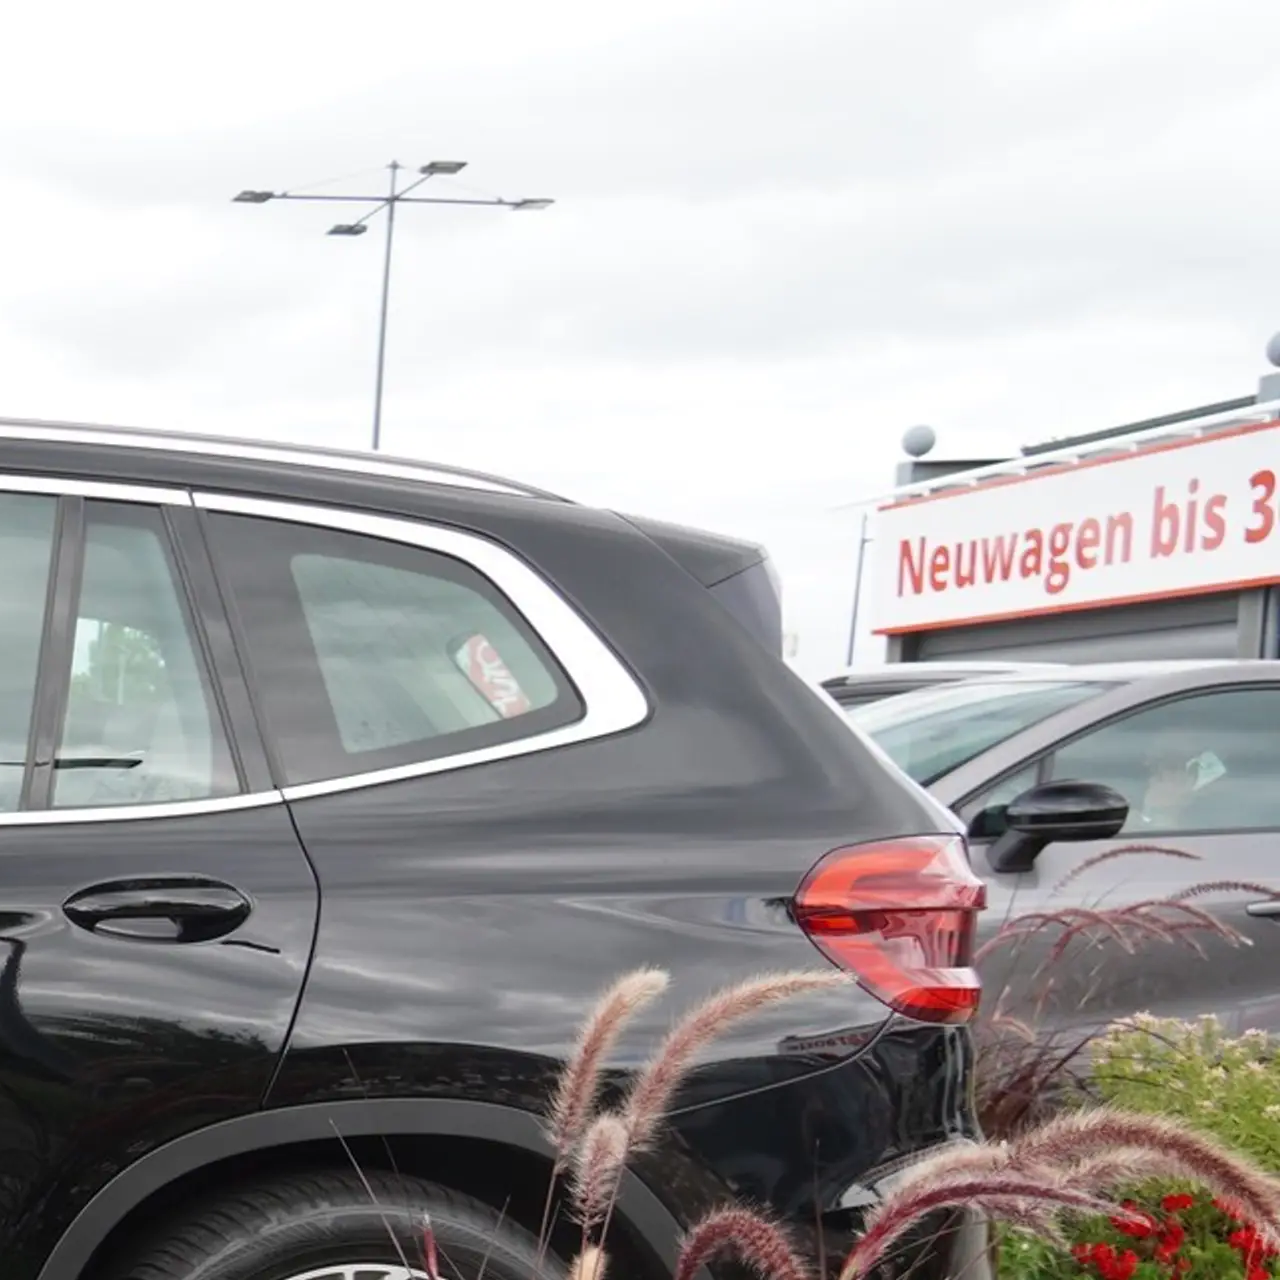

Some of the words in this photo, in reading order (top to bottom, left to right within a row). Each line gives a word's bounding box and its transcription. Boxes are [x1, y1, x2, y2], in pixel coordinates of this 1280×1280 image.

[898, 511, 1133, 597] Neuwagen
[1150, 478, 1227, 558] bis
[1244, 469, 1280, 544] 3
